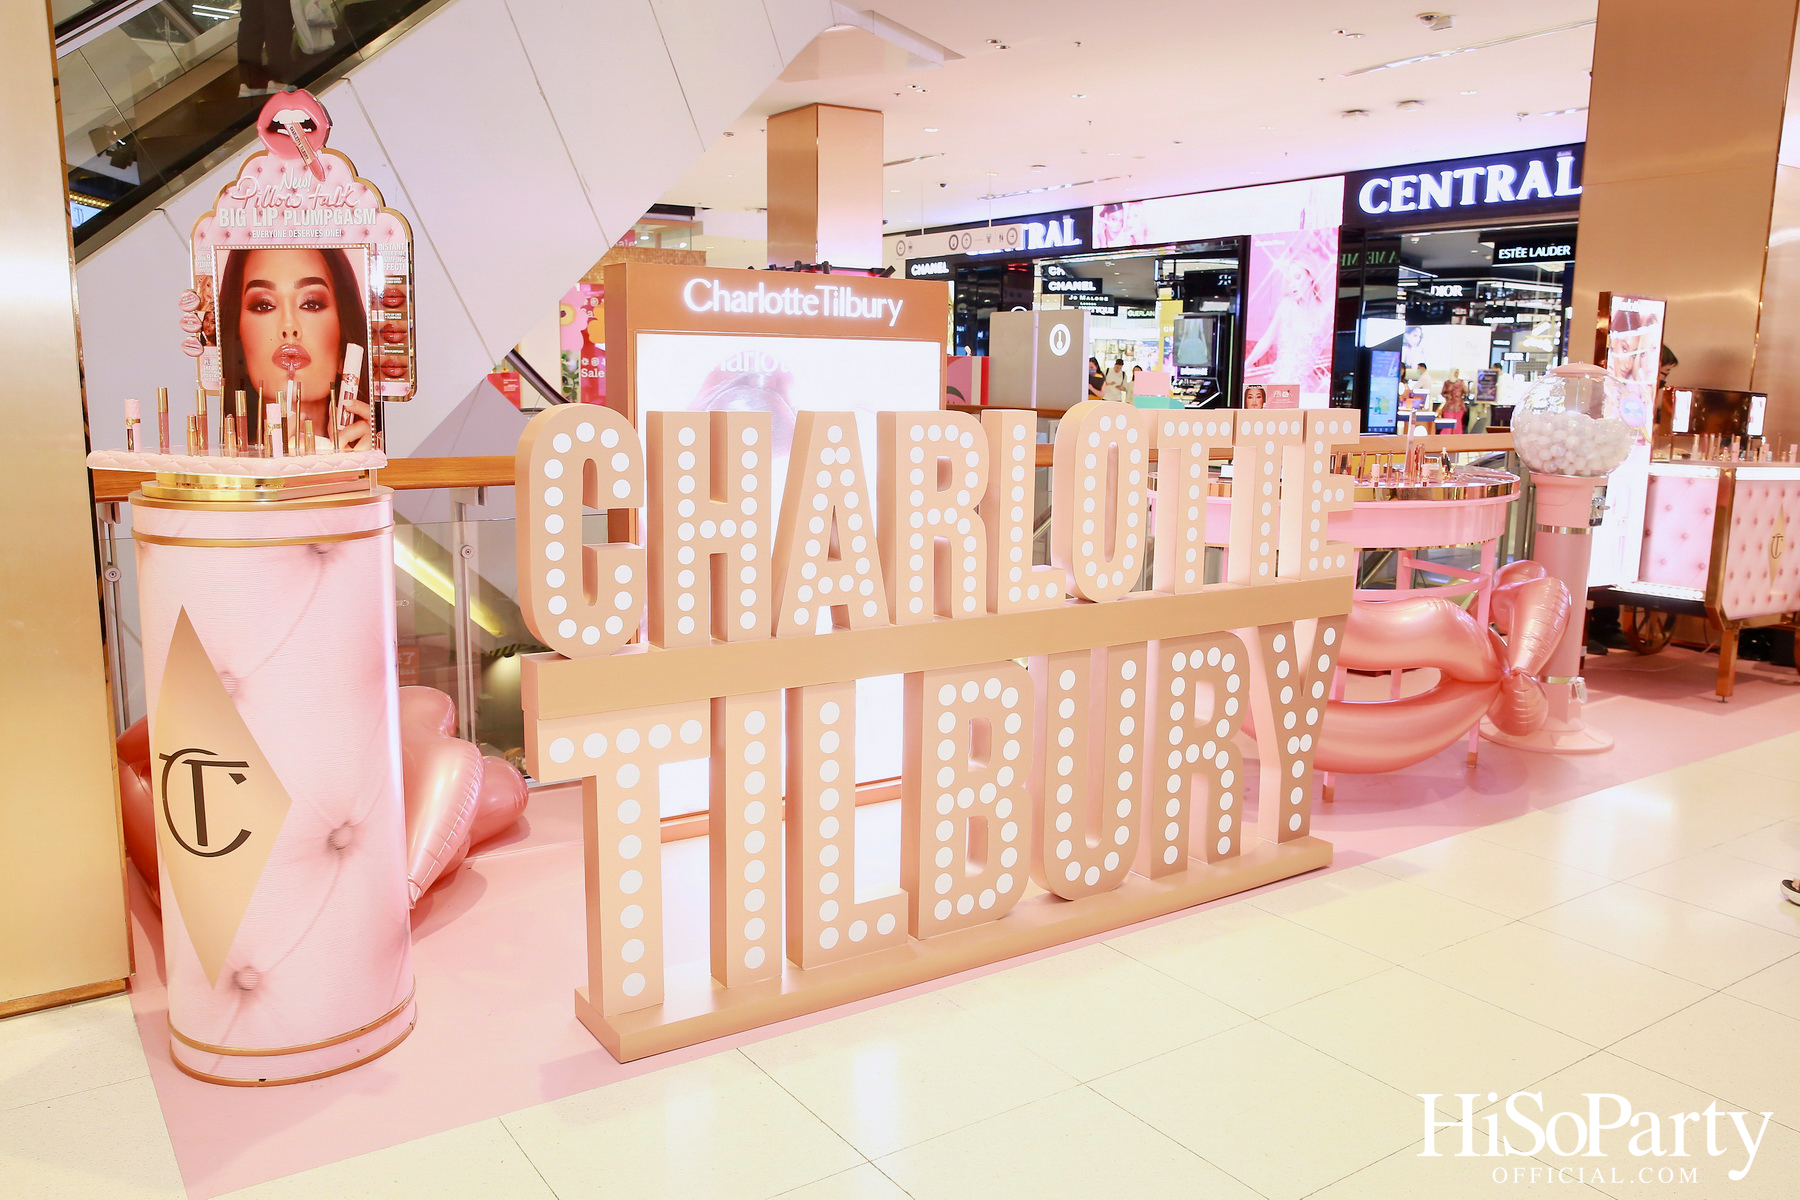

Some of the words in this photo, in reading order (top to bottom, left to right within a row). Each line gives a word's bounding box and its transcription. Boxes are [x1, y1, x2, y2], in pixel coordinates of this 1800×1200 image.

[280, 168, 312, 191] New!
[1358, 156, 1583, 214] CENTRAL
[230, 176, 303, 208] Pillow
[219, 208, 246, 227] BIG
[253, 208, 278, 226] LIP
[284, 207, 376, 225] PLUMPGASM
[252, 229, 287, 238] EVERYONE
[288, 229, 323, 237] DESERVES
[325, 228, 342, 237] ONE!
[1529, 245, 1571, 257] LAUDER
[911, 262, 949, 276] CHANEL
[1048, 281, 1096, 291] CHANEL
[1430, 285, 1463, 297] DIOR
[581, 368, 605, 378] Sale
[515, 402, 1360, 659] CHARLOTTE
[524, 614, 1348, 1018] TILBURY
